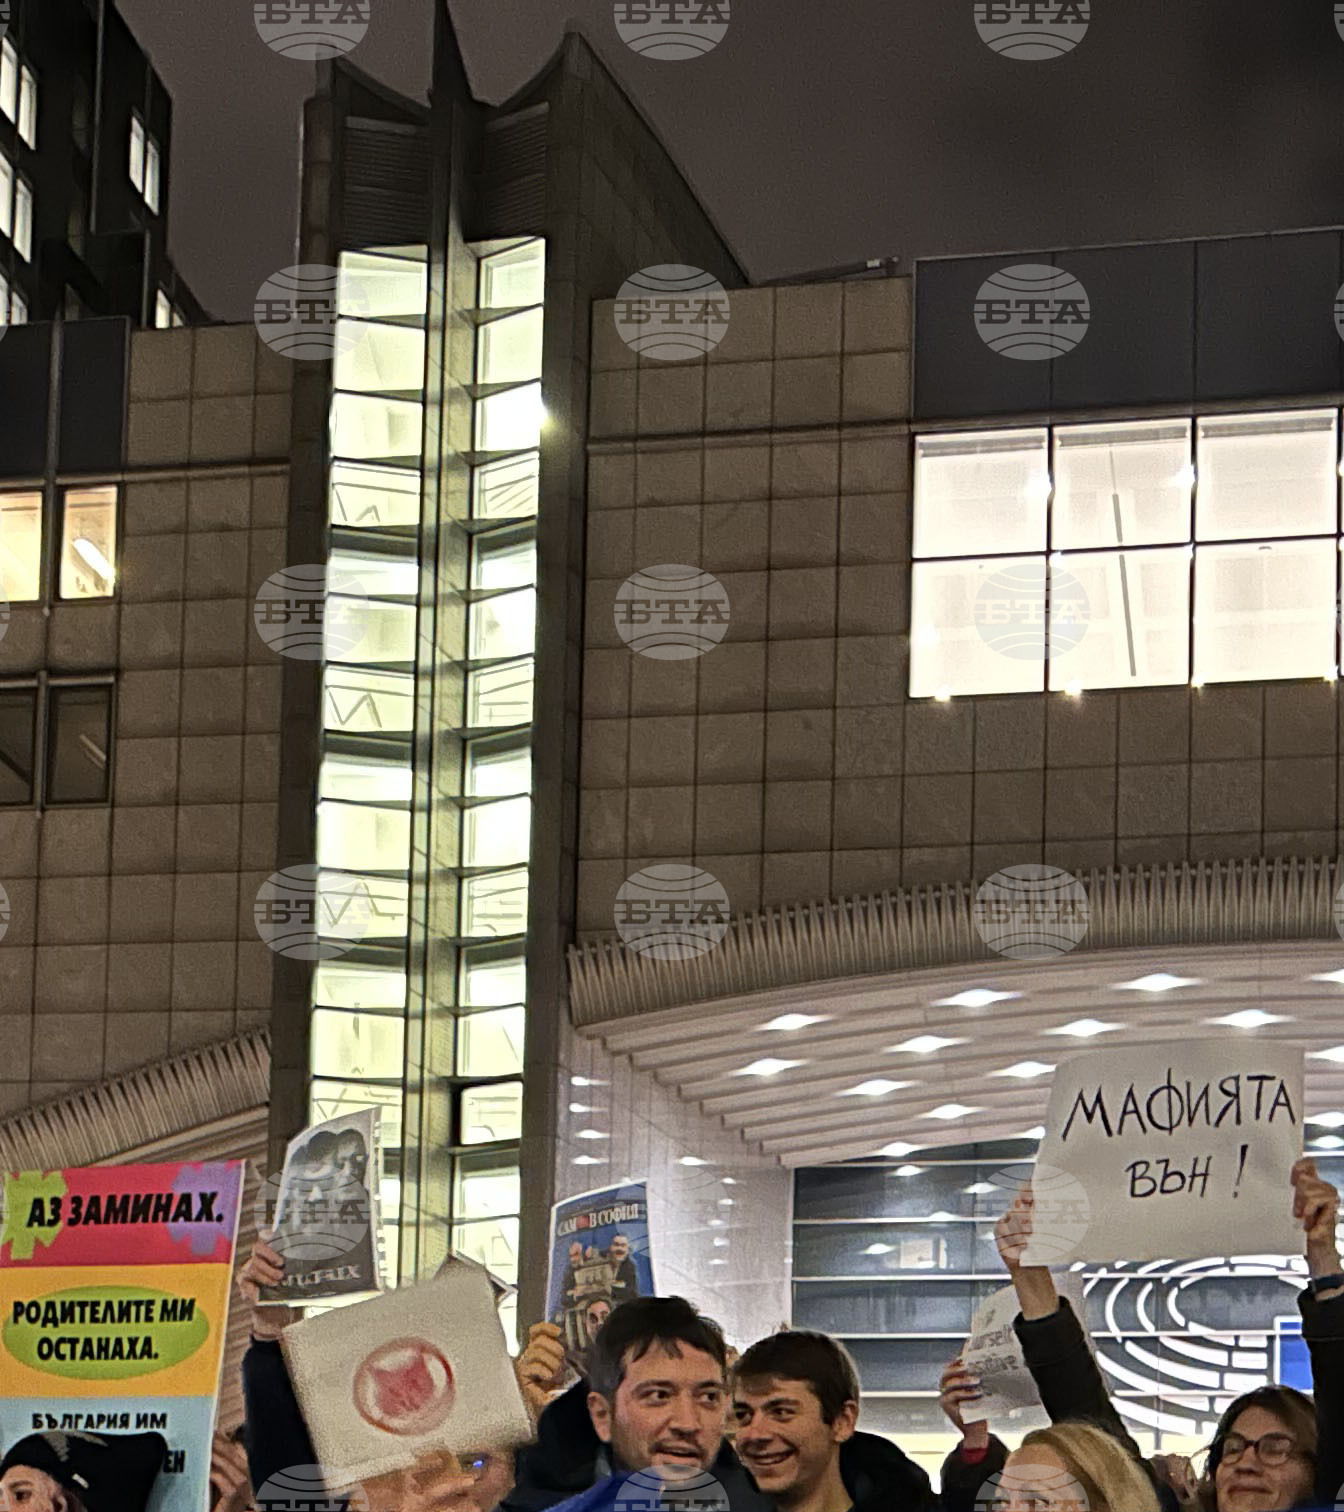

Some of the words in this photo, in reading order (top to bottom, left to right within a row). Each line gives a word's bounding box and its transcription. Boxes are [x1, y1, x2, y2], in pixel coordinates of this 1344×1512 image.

[1060, 1067, 1296, 1141] МАФИЯТА
[27, 1196, 61, 1228] АЗ
[67, 1190, 224, 1226] ЗАМИНАХ.
[12, 1299, 156, 1329] РОДИТЕЛИТЕ
[159, 1297, 196, 1323] МИ
[37, 1336, 160, 1362] ОСТАНАХА.
[31, 1412, 129, 1431] БЪЛГАРИЯ
[135, 1412, 168, 1430] ИМ
